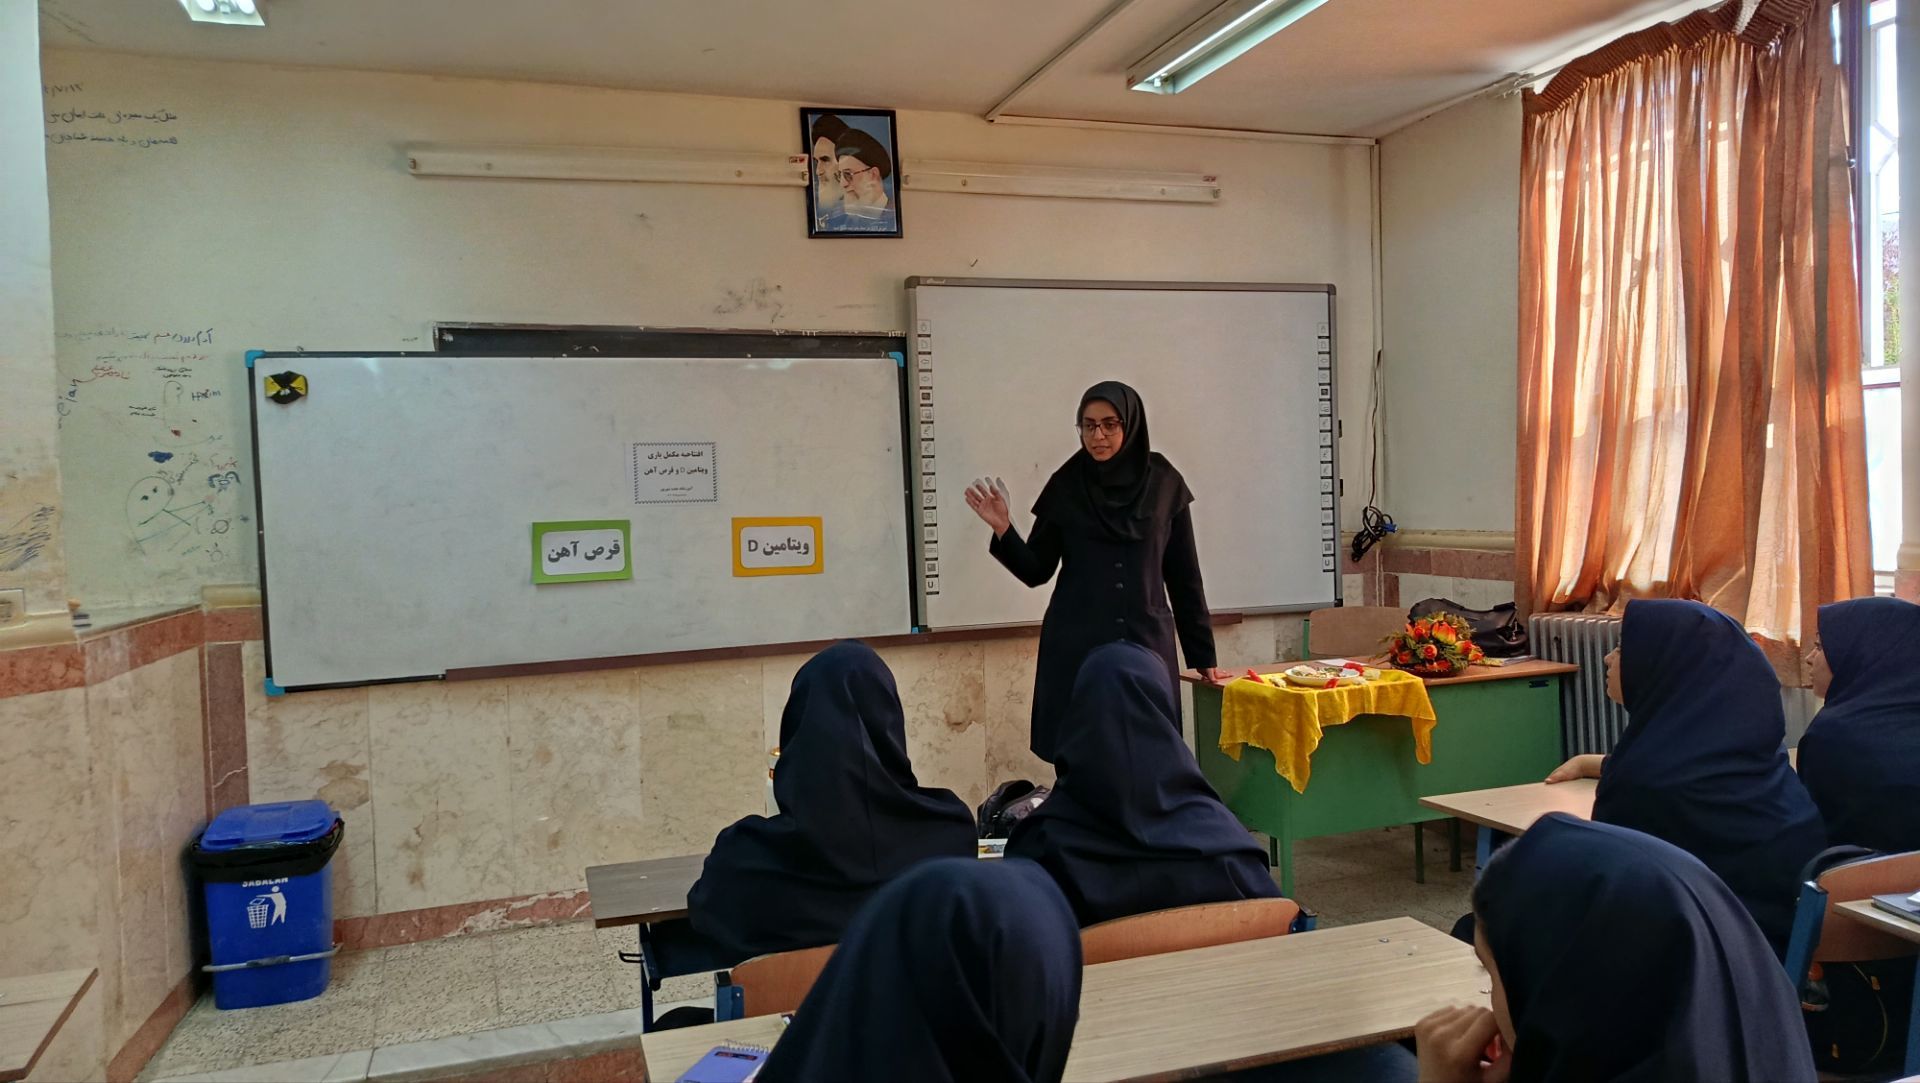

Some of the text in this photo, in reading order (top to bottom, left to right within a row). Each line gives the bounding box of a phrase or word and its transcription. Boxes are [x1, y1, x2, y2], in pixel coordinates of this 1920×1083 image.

[663, 451, 680, 459] مکمل
[644, 466, 657, 476] آهن
[659, 466, 674, 476] قرص
[687, 466, 708, 475] ویتامین
[547, 539, 621, 562] قرص آهن
[747, 537, 810, 556] ویتامین D
